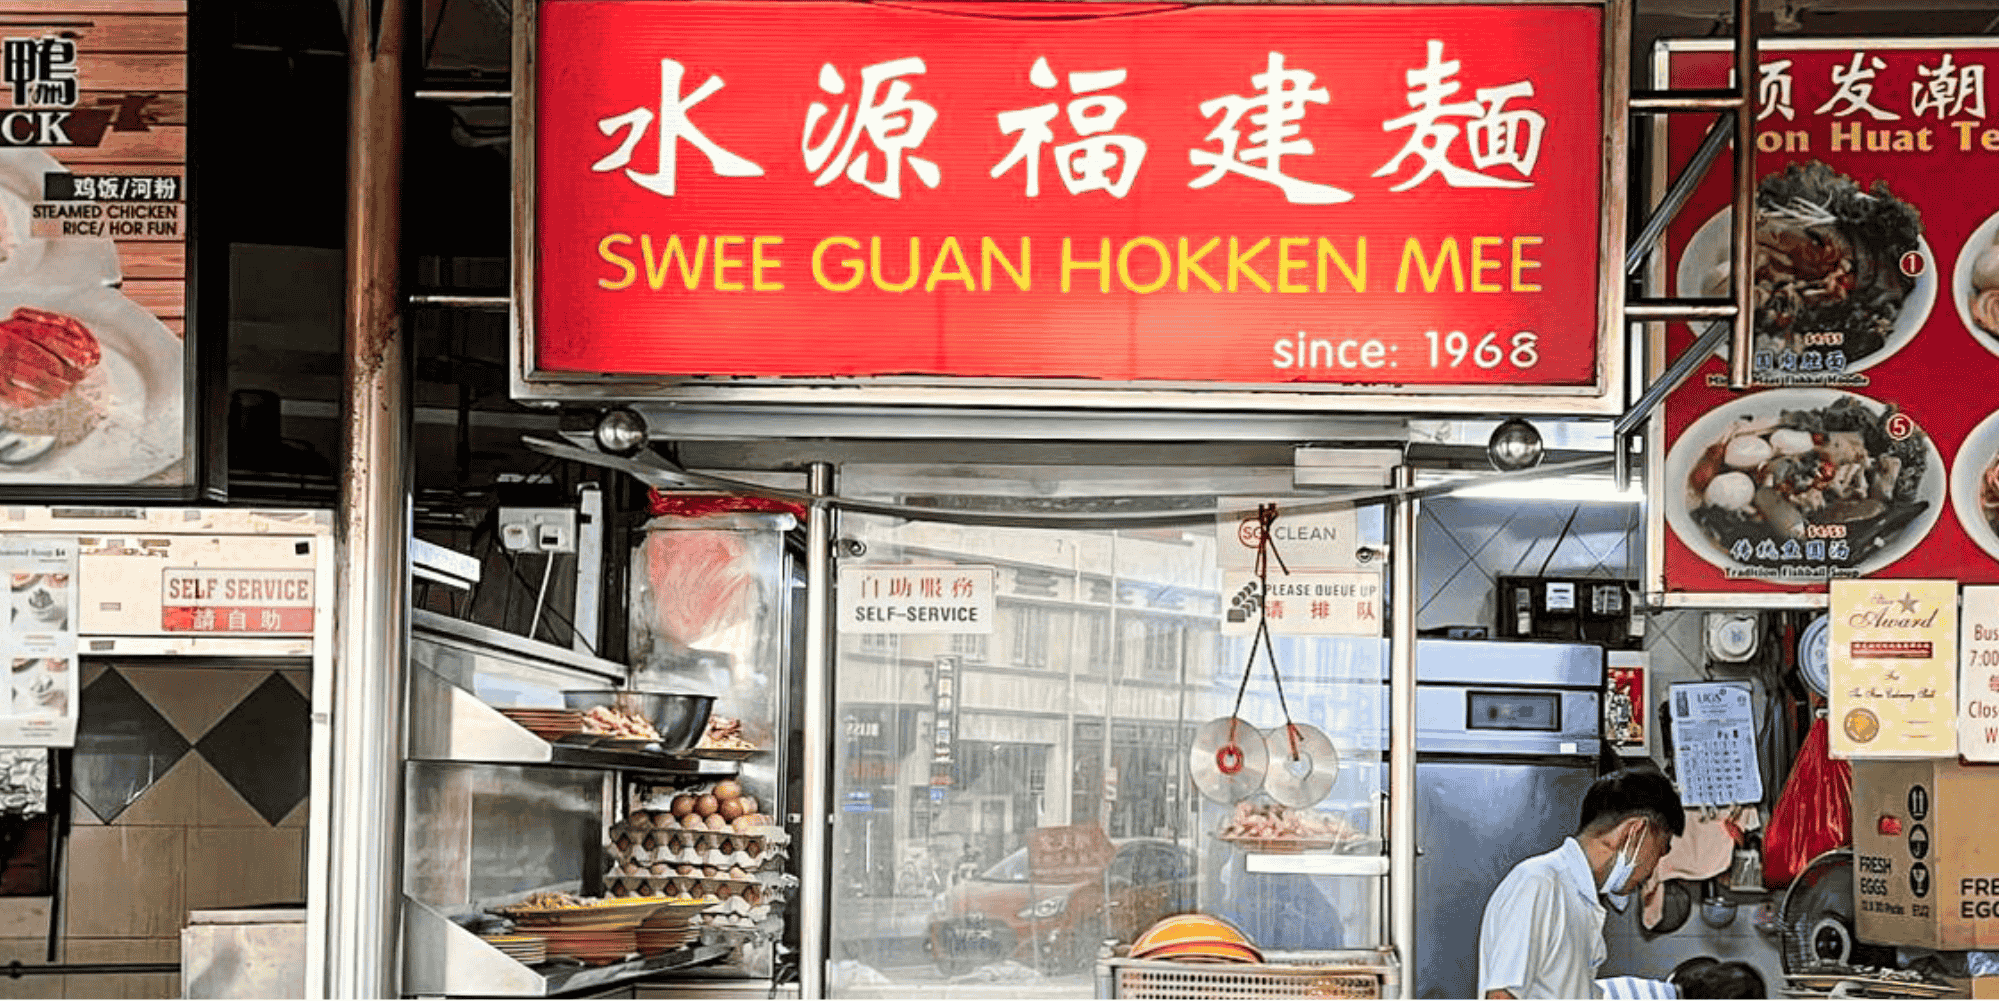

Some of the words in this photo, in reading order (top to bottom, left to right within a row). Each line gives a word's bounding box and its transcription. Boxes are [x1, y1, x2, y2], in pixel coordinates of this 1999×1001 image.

[1830, 121, 1933, 152] Huat
[73, 177, 176, 199] 鸡饭/河粉
[32, 204, 102, 219] STEAMED
[106, 204, 177, 219] CHICKEN
[63, 221, 105, 236] RICE/
[109, 221, 143, 235] HOR
[147, 221, 177, 235] FUN
[598, 233, 784, 291] SWEE
[812, 236, 1031, 292] GUAN
[1060, 236, 1367, 293] HOKKEN
[1396, 236, 1543, 293] MEE
[1273, 331, 1398, 369] since:
[1425, 330, 1539, 369] 1968
[1274, 527, 1337, 540] CLEAN
[169, 578, 218, 600] SELF
[225, 578, 309, 600] SERVICE
[1266, 584, 1311, 597] PLEASE
[1314, 584, 1356, 597] QUEUE
[1360, 585, 1377, 597] UP
[1265, 600, 1376, 620] 请排队
[1849, 607, 1940, 629] Award
[1860, 857, 1891, 874] FRESH
[1860, 878, 1887, 895] EGGS
